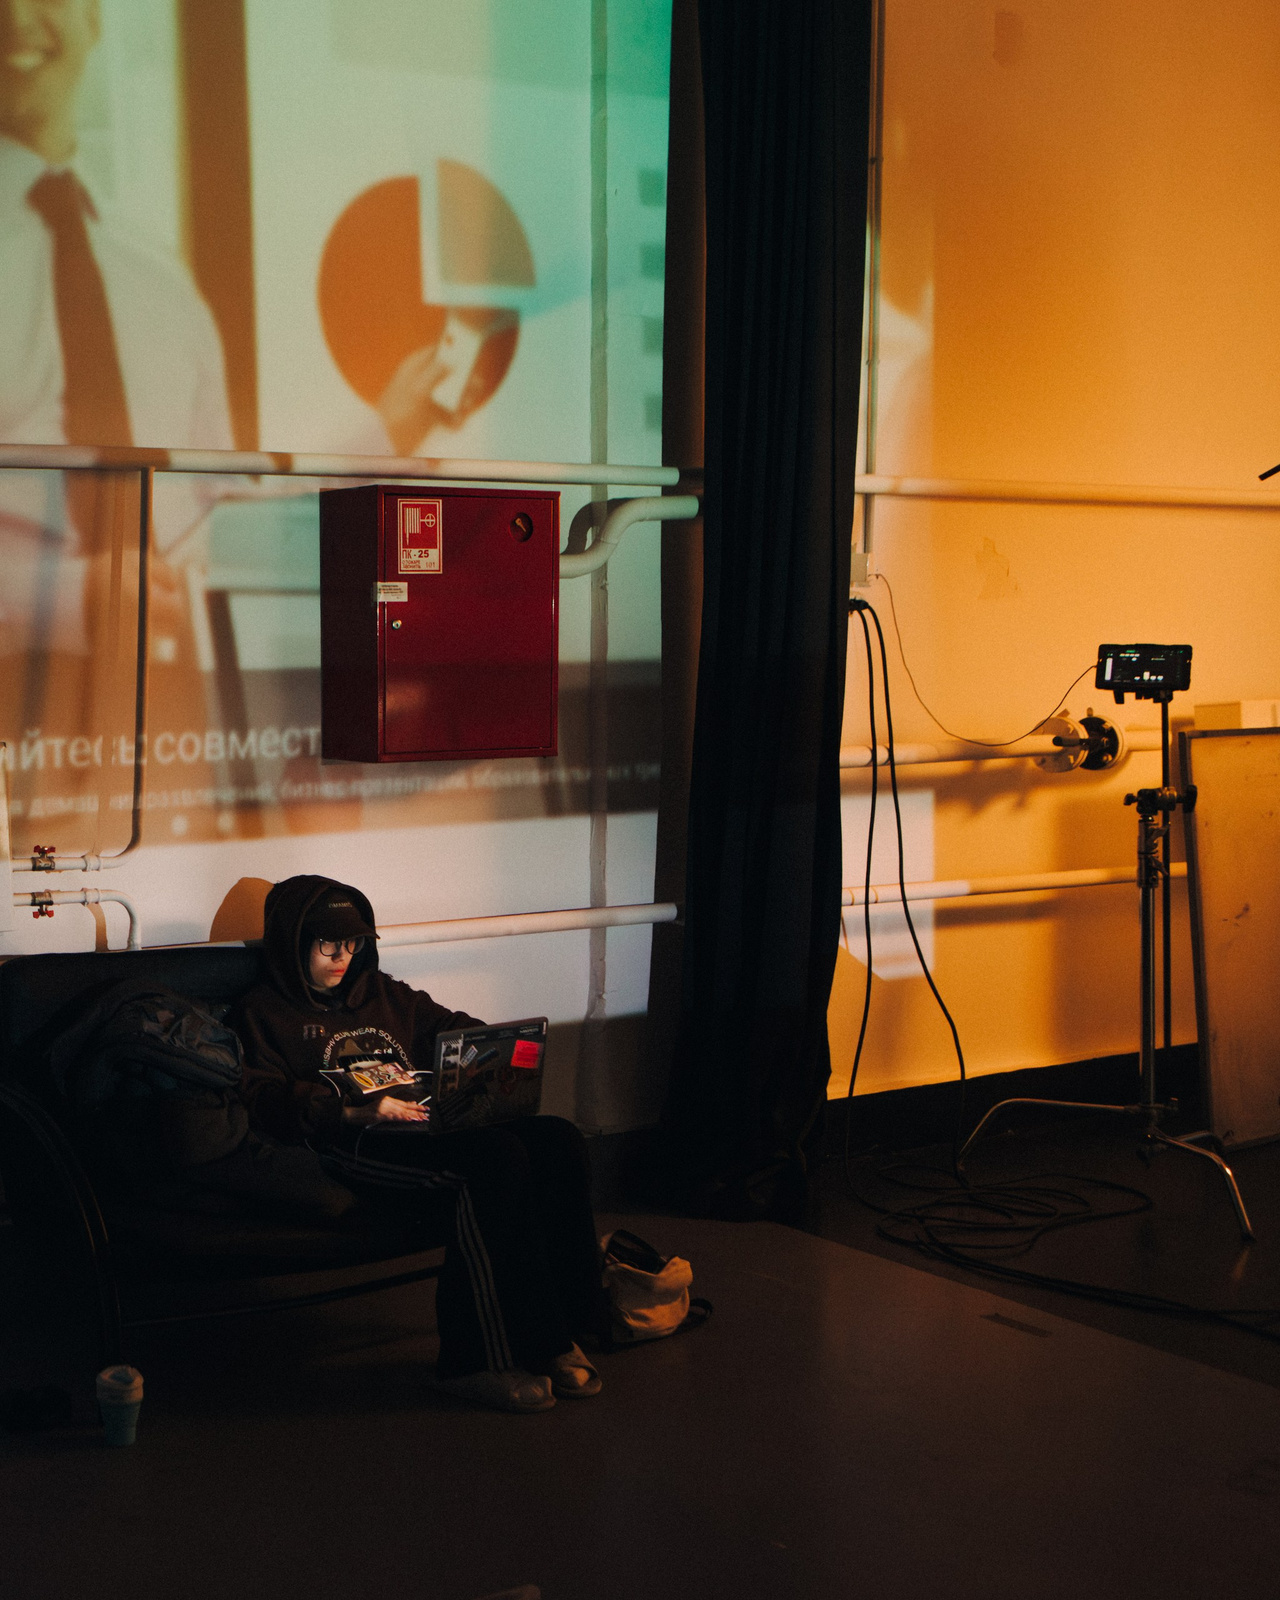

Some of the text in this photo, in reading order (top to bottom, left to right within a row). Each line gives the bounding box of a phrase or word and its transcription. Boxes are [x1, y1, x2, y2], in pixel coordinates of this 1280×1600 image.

[402, 549, 412, 559] ПК
[418, 550, 429, 558] 25
[350, 1027, 377, 1038] WEAR
